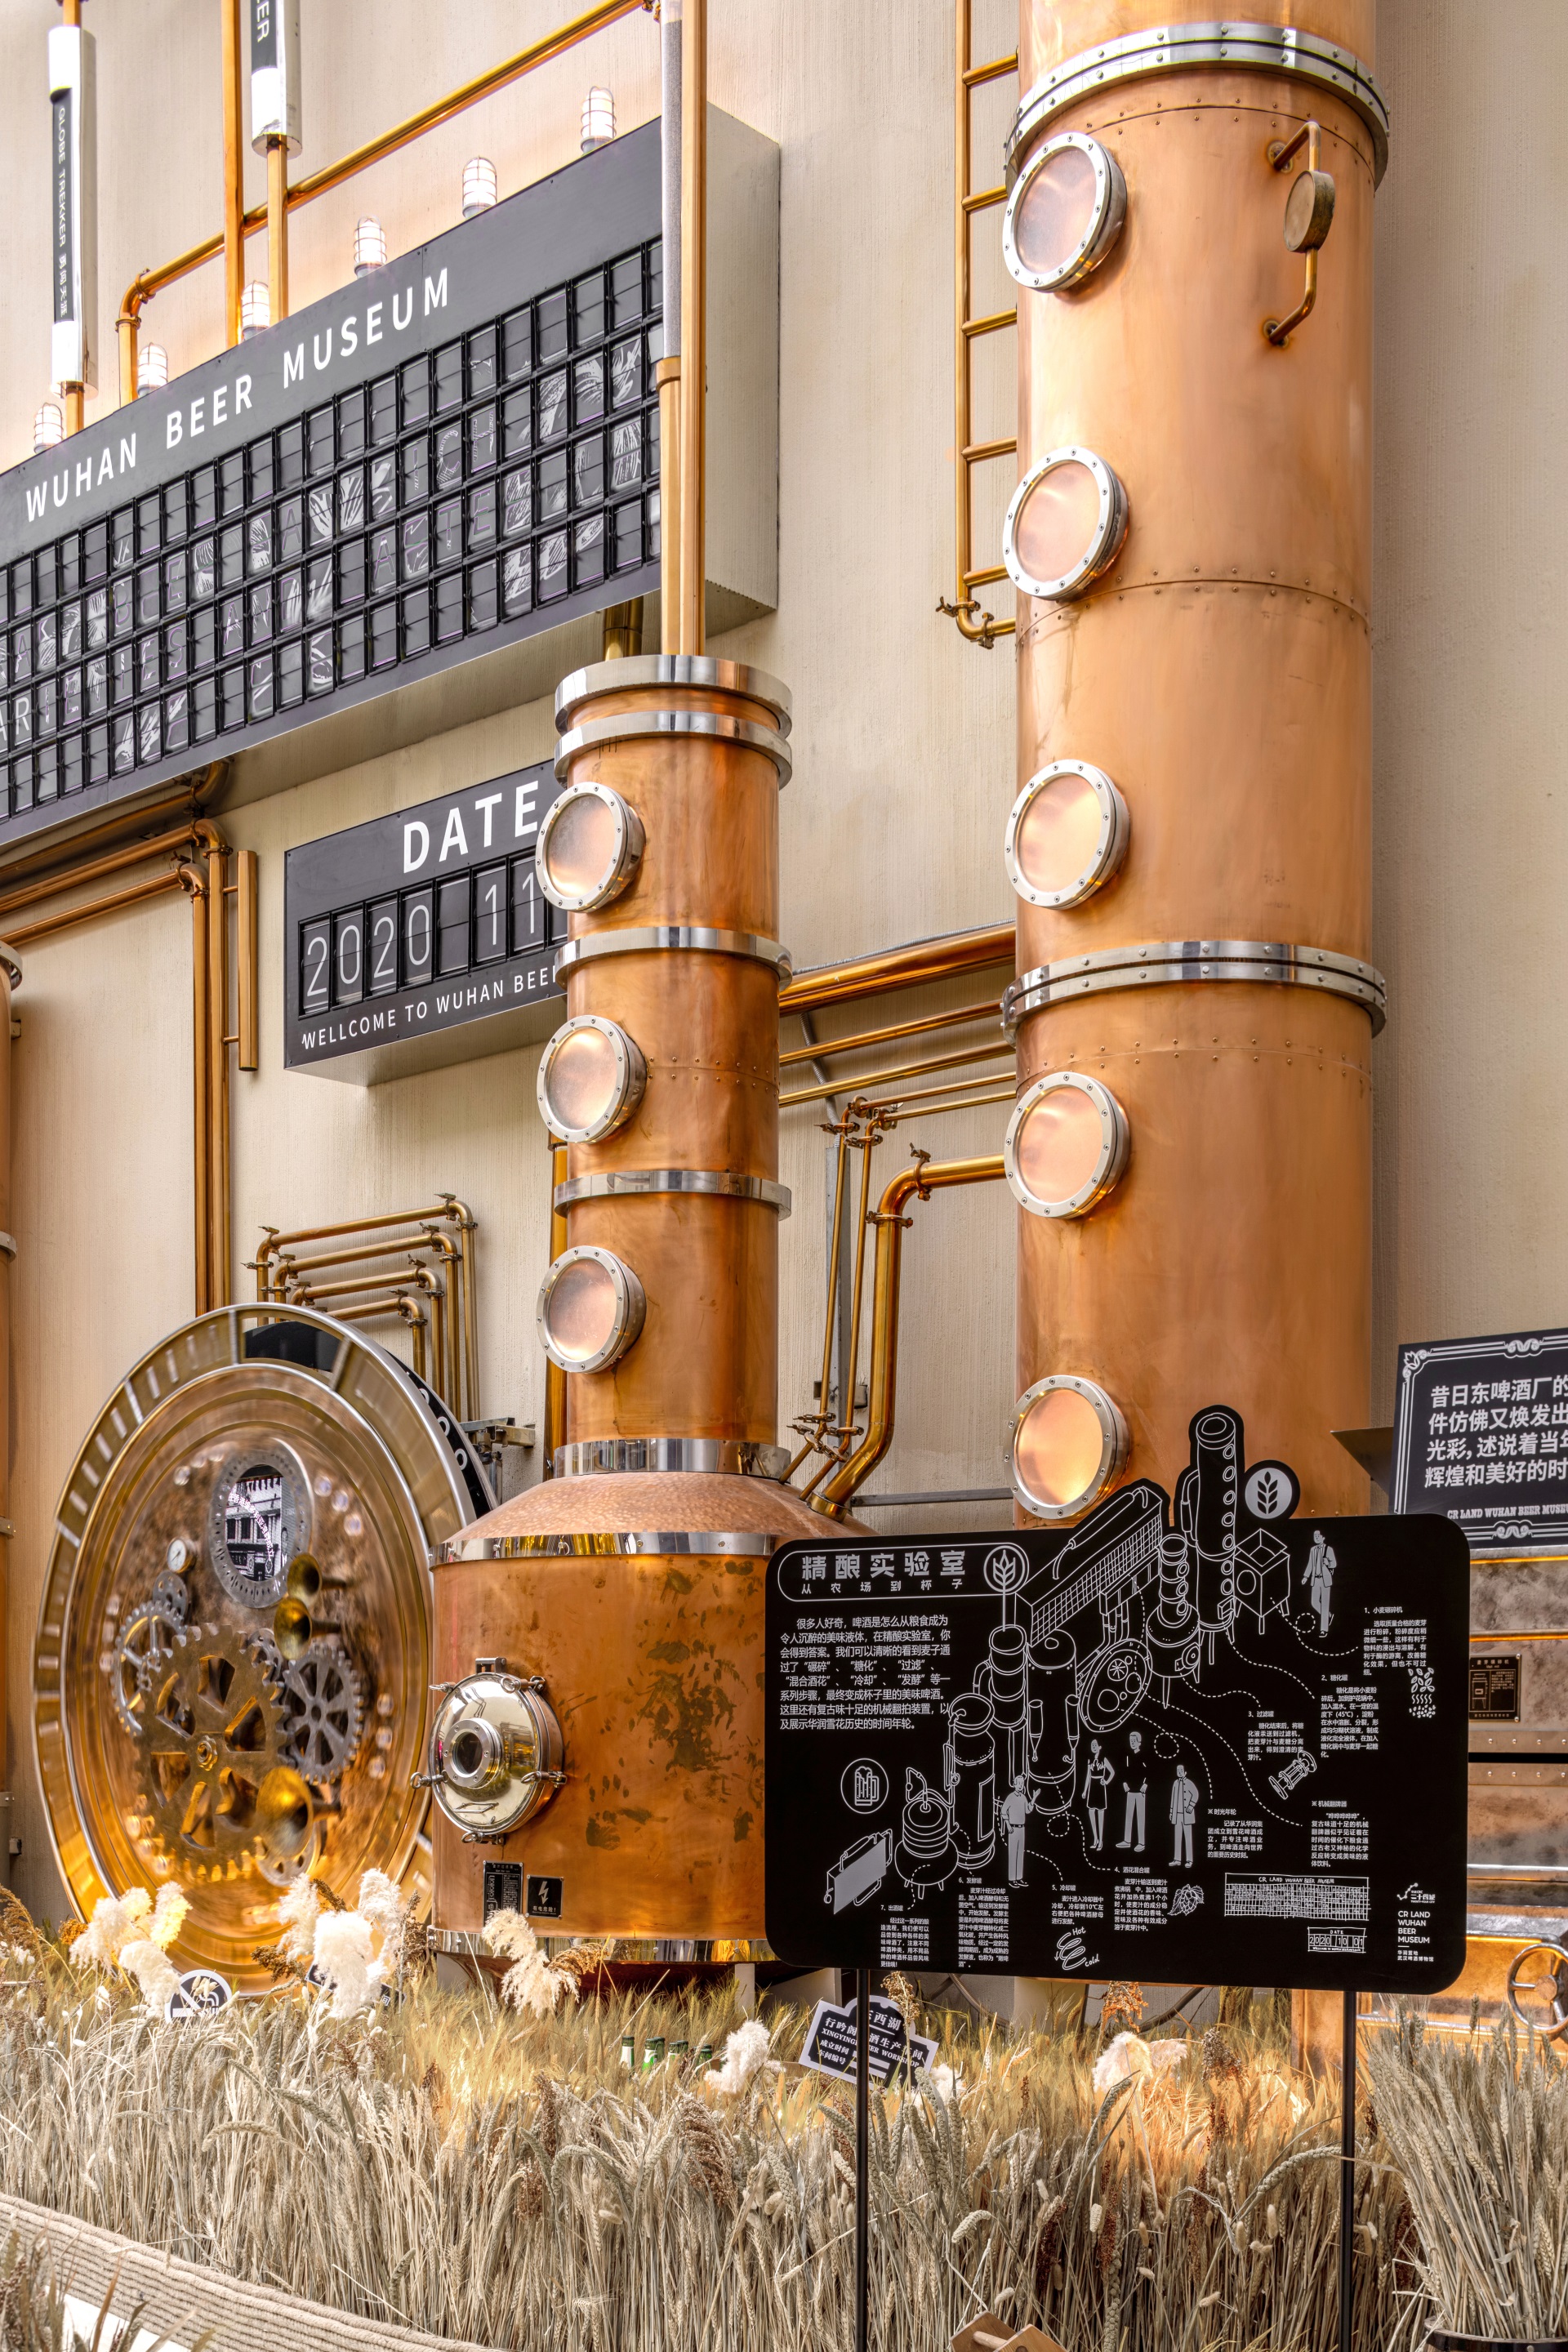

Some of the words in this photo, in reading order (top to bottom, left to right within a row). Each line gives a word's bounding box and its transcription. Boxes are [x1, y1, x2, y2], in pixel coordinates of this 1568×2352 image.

[256, 0, 270, 42] ER
[57, 107, 66, 164] GLOBE
[58, 167, 67, 247] TREKKER
[25, 433, 137, 522] WUHAN
[166, 374, 253, 448] BEER
[283, 268, 448, 388] MUSEUM
[403, 781, 539, 873] DATE
[307, 904, 430, 997] 2020
[485, 872, 536, 946] 11
[301, 1009, 395, 1049] WELLCOME
[405, 1001, 427, 1022] TO
[437, 980, 504, 1013] WUHAN
[514, 964, 556, 991] BEE
[1431, 1374, 1568, 1408] 昔日东啤酒厂的
[1428, 1402, 1568, 1435] 件仿佛又焕发出
[1424, 1457, 1568, 1488] 辉煌和美好的时
[1447, 1510, 1459, 1519] CR
[1460, 1508, 1483, 1519] LAND
[1485, 1507, 1517, 1517] WUHAN
[1518, 1505, 1540, 1516] BEER
[801, 1550, 965, 1580] 精酿实验室
[801, 1579, 963, 1594] 从农场到杯子
[1072, 1927, 1086, 1936] Hot
[1309, 1936, 1330, 1944] 2020
[1338, 1937, 1348, 1945] 10
[1353, 1938, 1363, 1946] 01
[1085, 1953, 1100, 1967] cold
[820, 2039, 849, 2055] 成立时间
